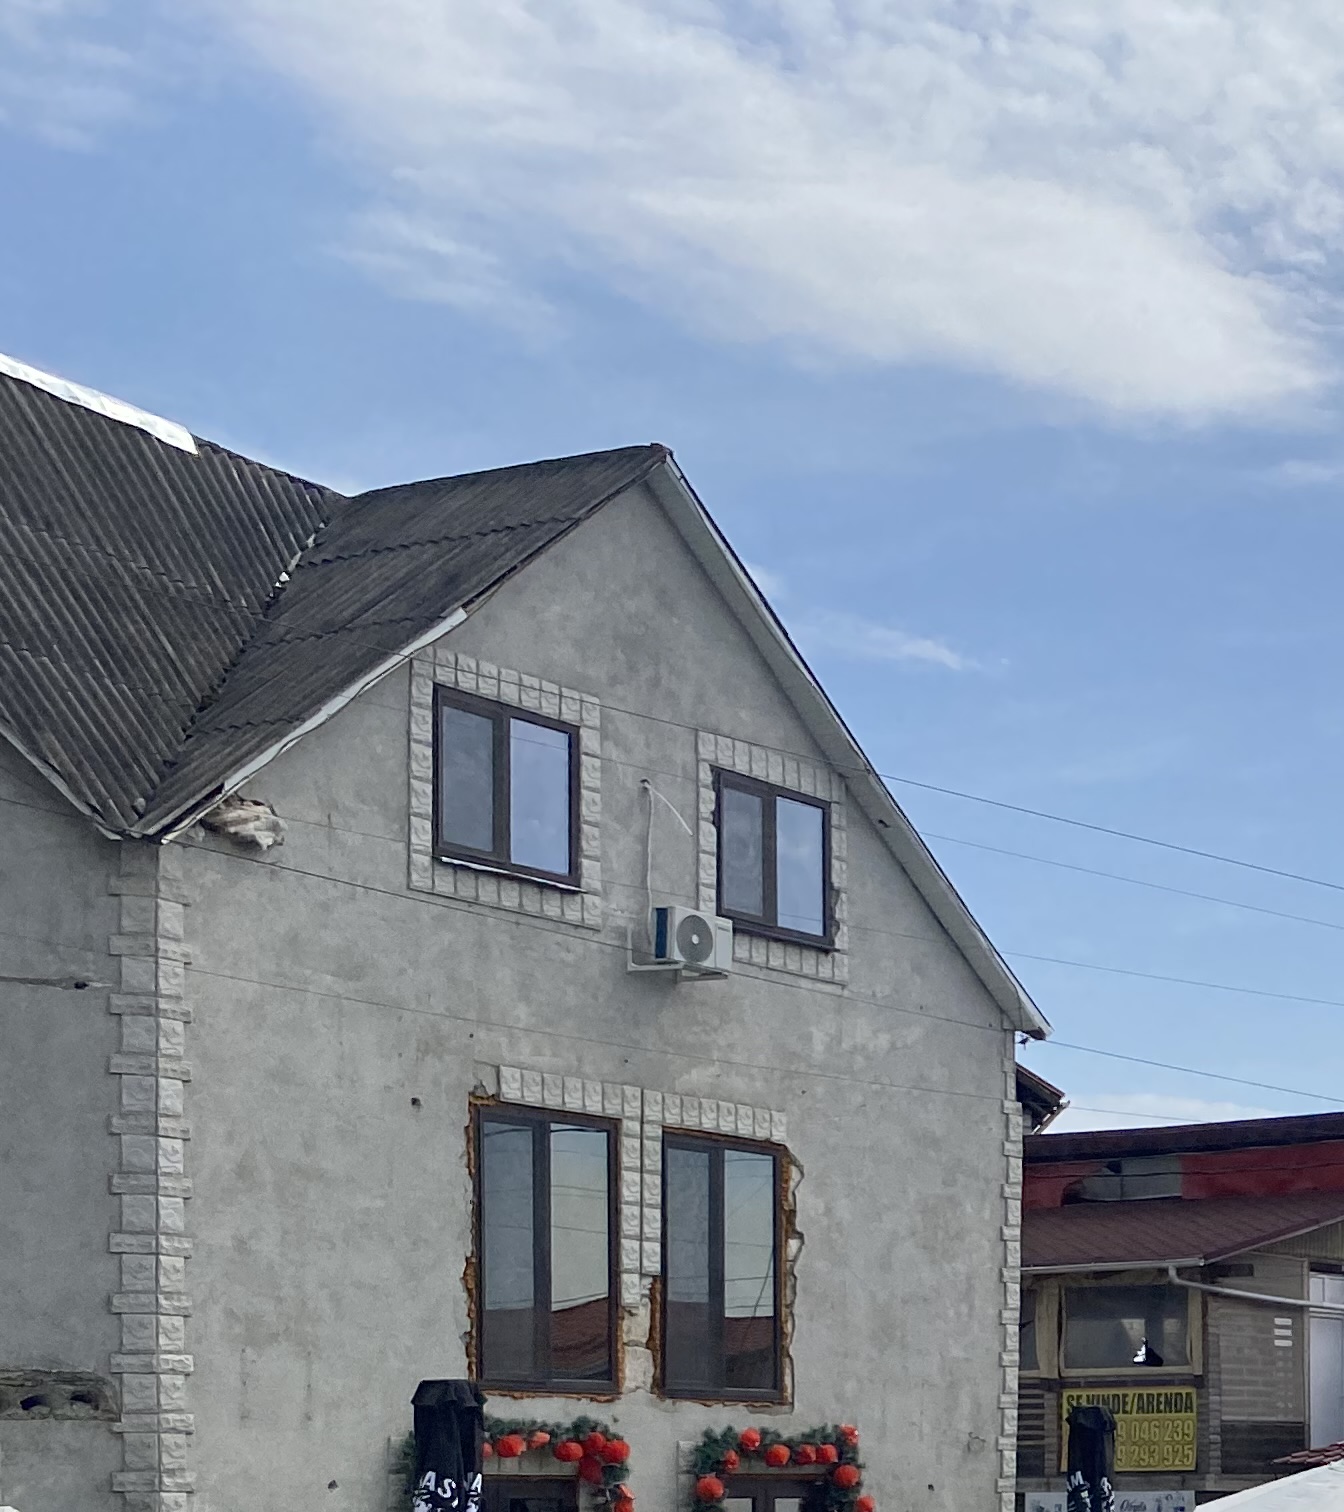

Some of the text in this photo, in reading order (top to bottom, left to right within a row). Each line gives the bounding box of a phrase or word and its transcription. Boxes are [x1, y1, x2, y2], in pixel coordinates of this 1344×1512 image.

[1130, 1420, 1160, 1442] 046
[1163, 1419, 1194, 1442] 239
[1130, 1445, 1159, 1467] 293
[1163, 1443, 1194, 1466] 925
